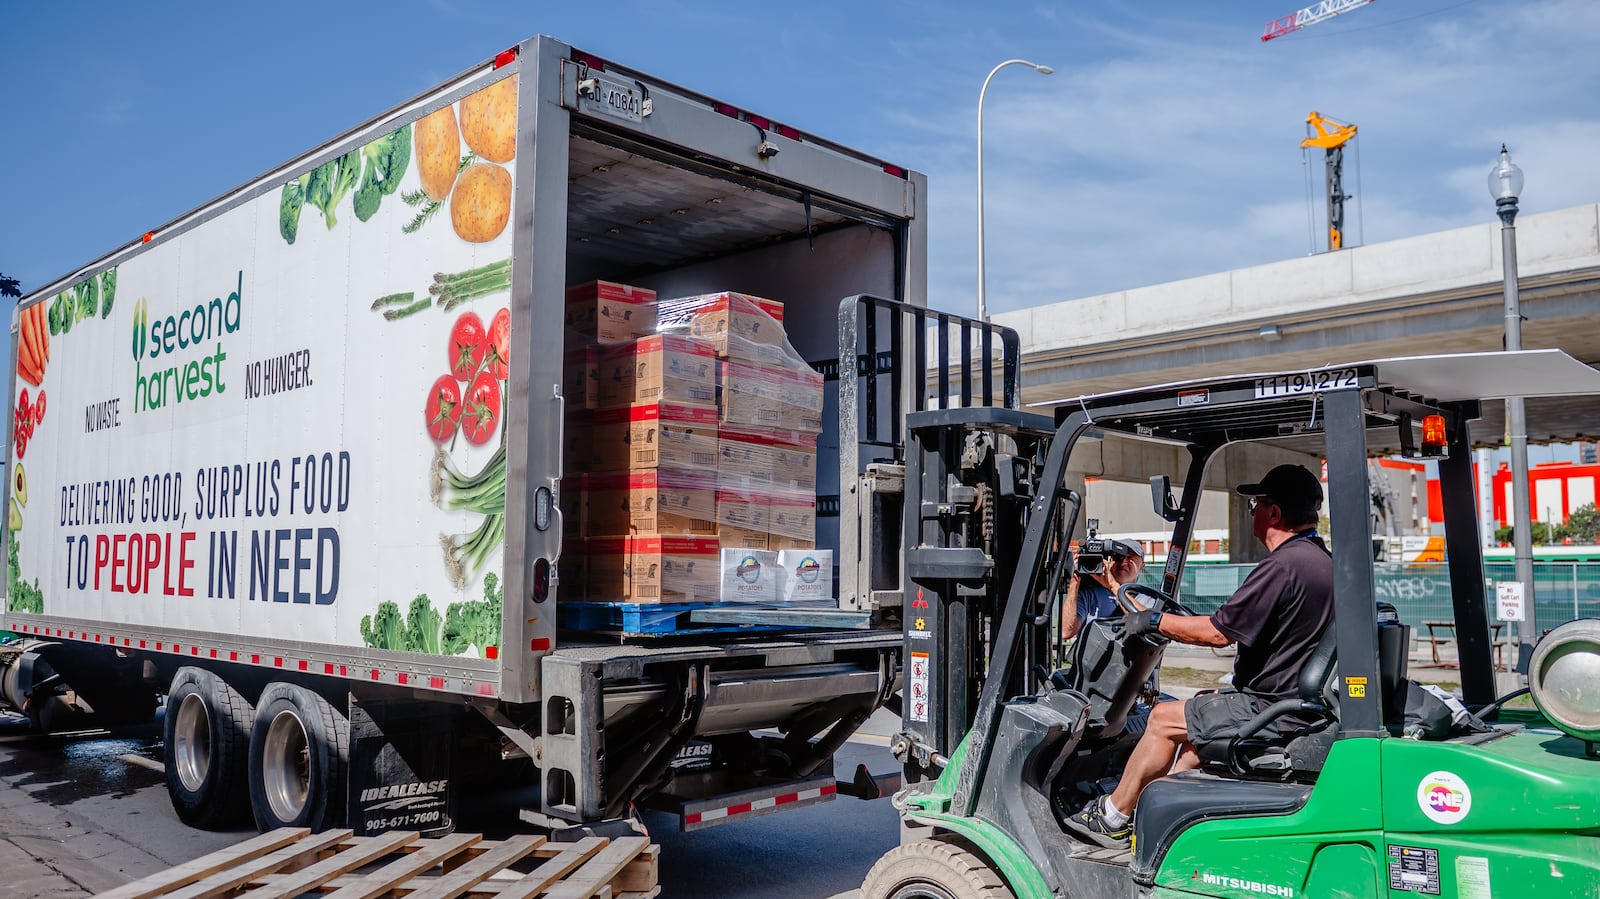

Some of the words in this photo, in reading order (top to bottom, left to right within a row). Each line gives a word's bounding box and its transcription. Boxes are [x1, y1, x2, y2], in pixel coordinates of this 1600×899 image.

[150, 270, 243, 358] second
[134, 342, 227, 413] harvest
[245, 361, 261, 399] NO
[263, 349, 313, 396] HUNGER.
[85, 404, 95, 433] NO
[96, 398, 121, 431] WASTE.
[60, 477, 136, 527] DELIVERING
[141, 472, 188, 529] GOOD,
[195, 459, 281, 520] SURPLUS
[290, 451, 351, 515] FOOD
[66, 534, 89, 590] TO
[94, 531, 196, 597] PEOPLE
[208, 530, 238, 599] IN
[249, 527, 341, 606] NEED
[1350, 687, 1364, 695] LPG
[360, 780, 449, 802] IDEALEASE
[1429, 791, 1463, 808] CNE
[366, 811, 440, 831] 905-671-7600
[1203, 873, 1293, 898] MITSUBISHI
